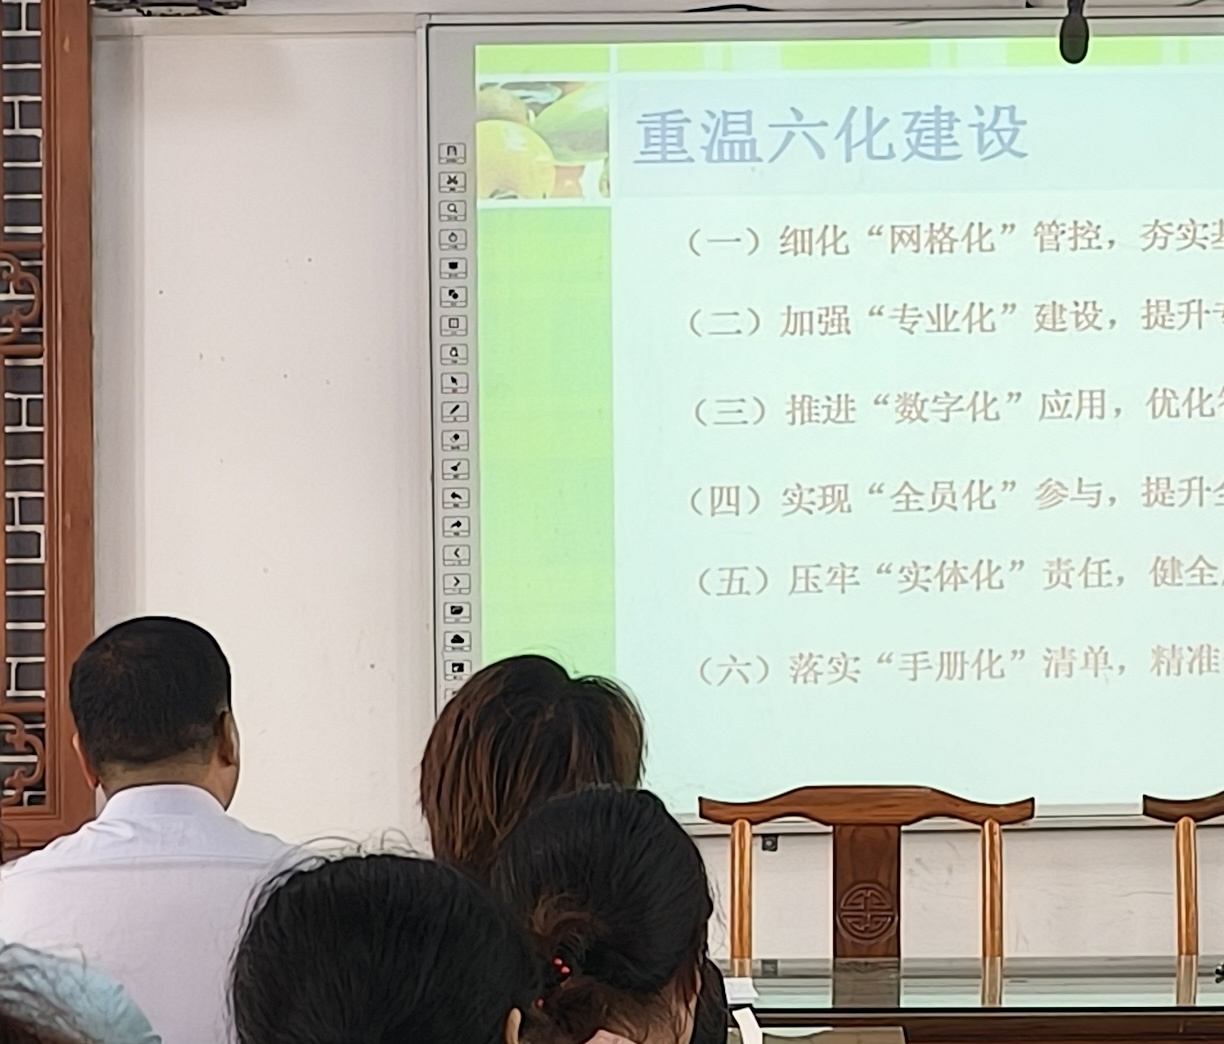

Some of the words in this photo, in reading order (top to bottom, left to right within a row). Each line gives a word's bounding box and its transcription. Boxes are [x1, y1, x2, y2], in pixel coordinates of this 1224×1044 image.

[632, 104, 1029, 166] 重温六化建设
